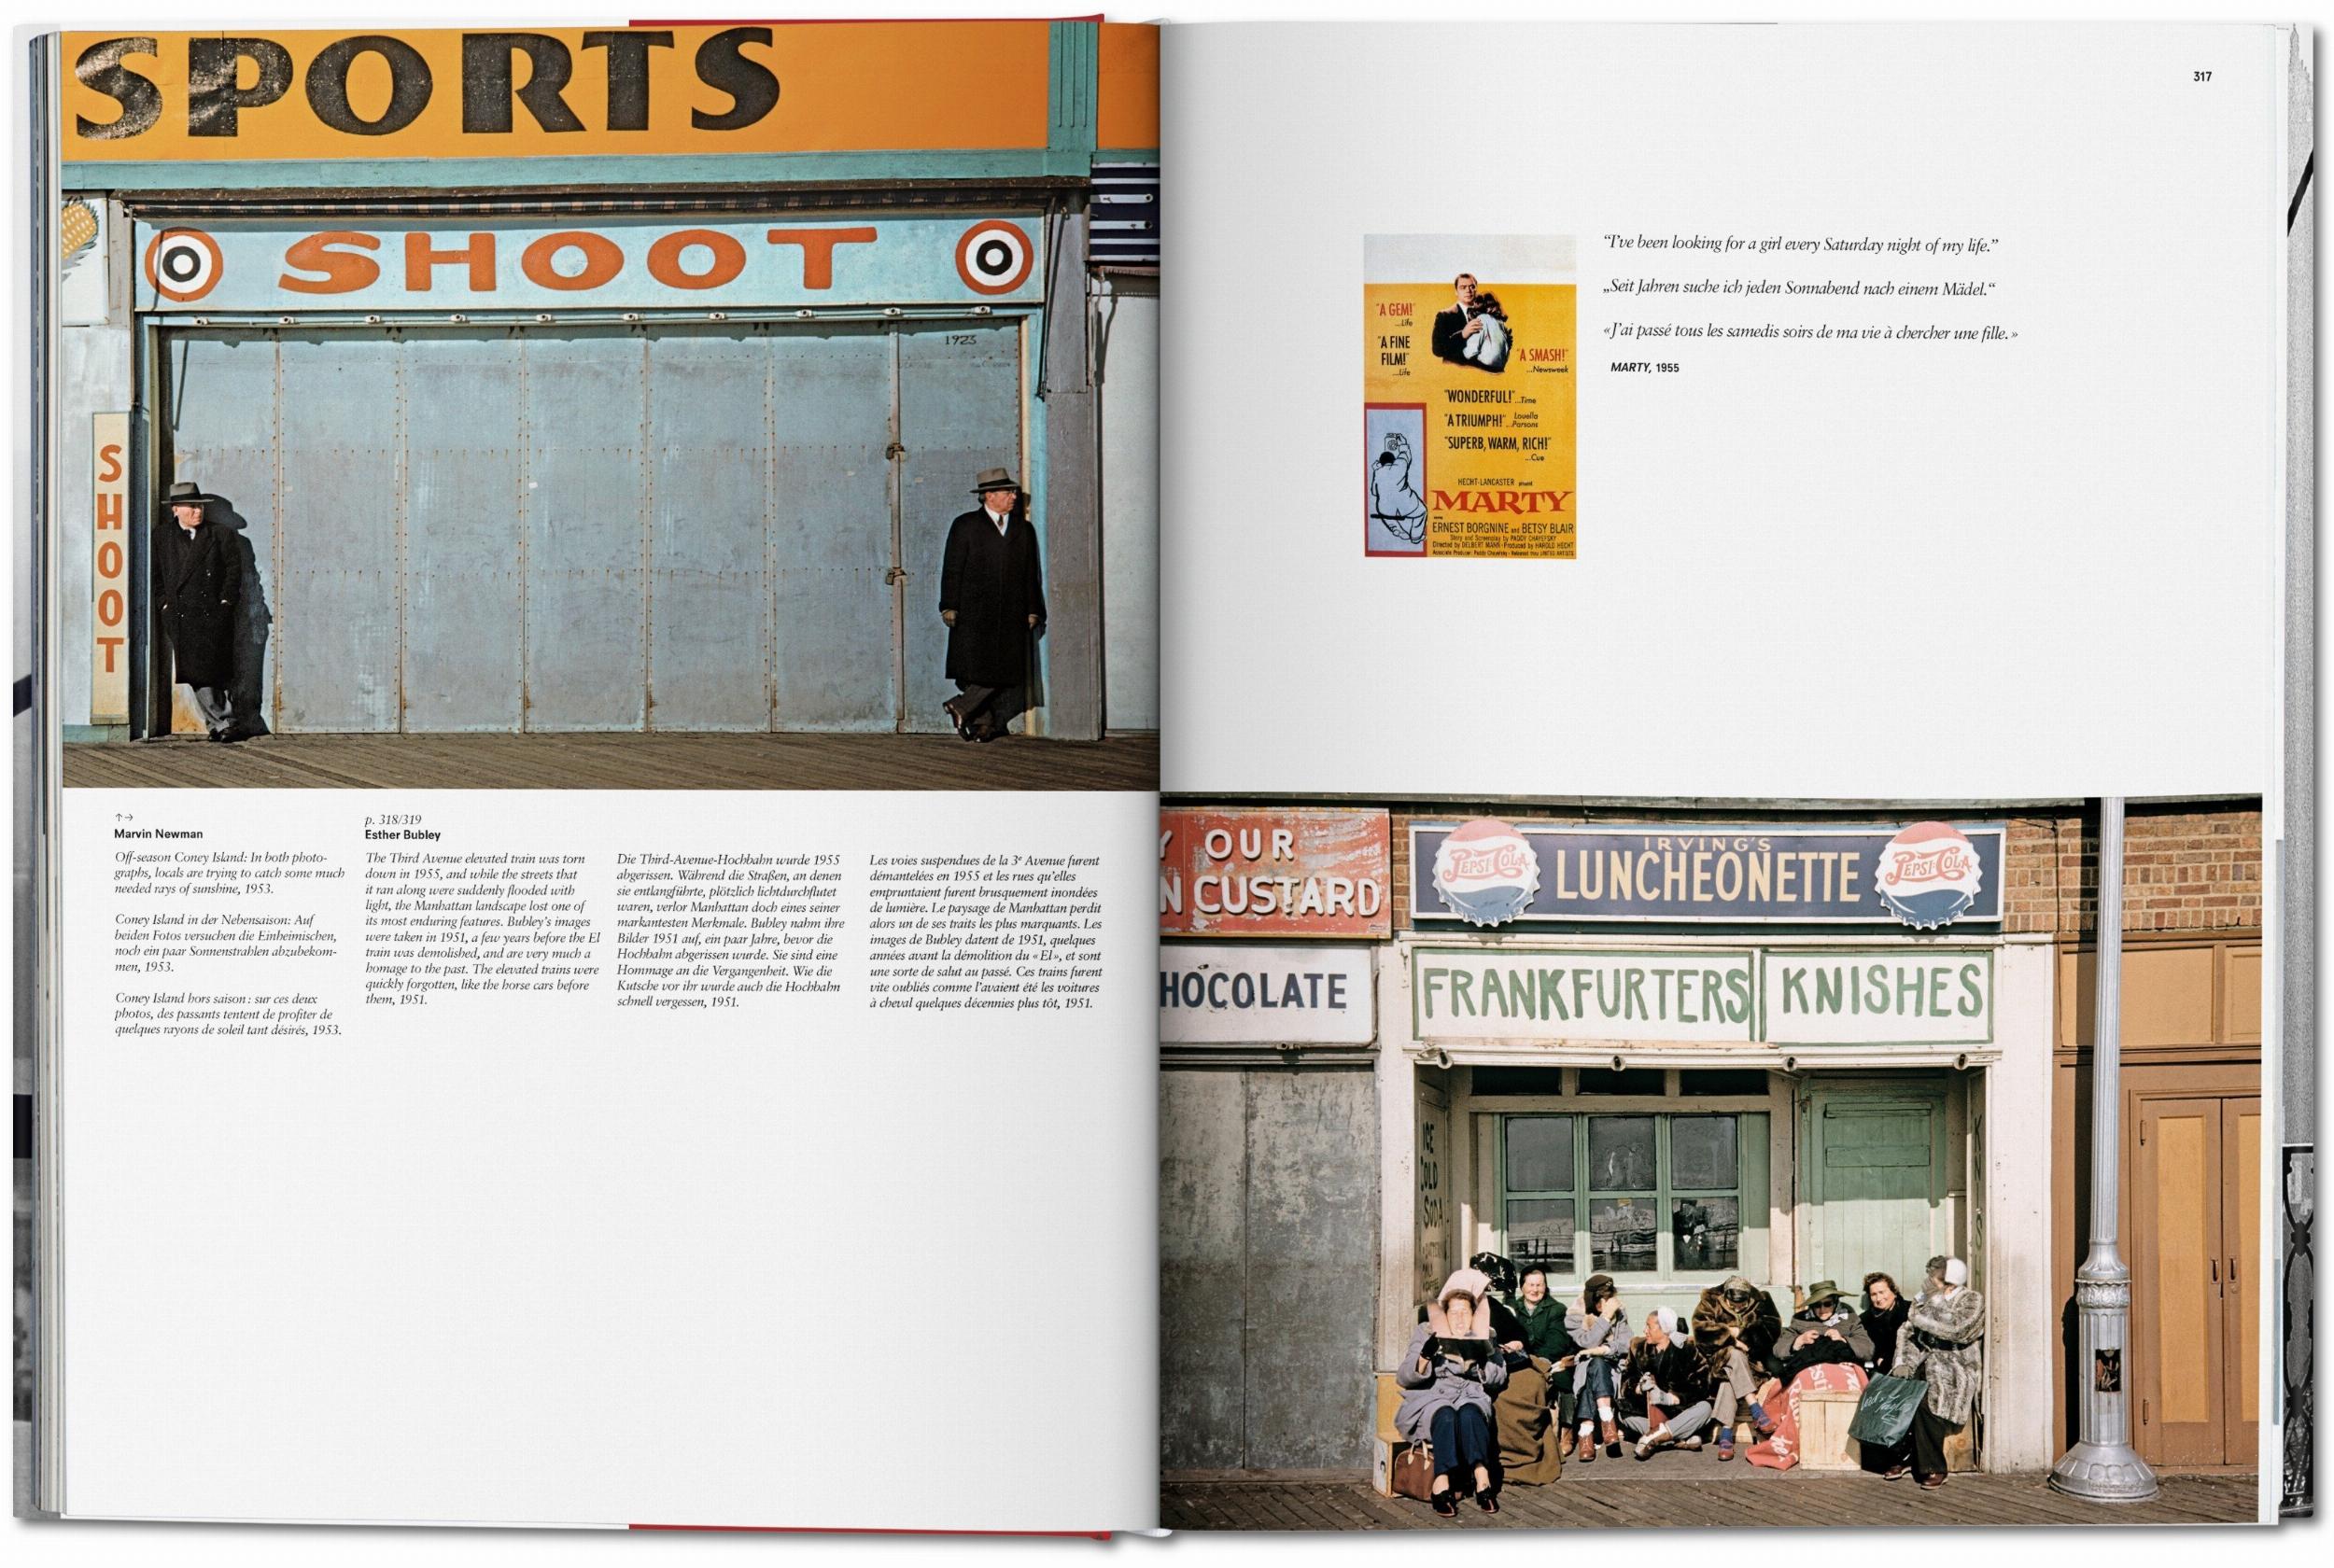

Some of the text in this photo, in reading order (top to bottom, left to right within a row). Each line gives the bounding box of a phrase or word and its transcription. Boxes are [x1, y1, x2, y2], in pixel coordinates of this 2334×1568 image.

[76, 26, 780, 140] SPORTS
[2193, 70, 2213, 82] 317
[1603, 233, 2000, 257] “I’ve been looking for a girl every Saturday night of my life.”
[278, 228, 879, 295] SHOOT
[1602, 278, 1996, 298] „Seit Jahren suche ich jeden Sonnabend nach einem Mädel.“
[1603, 321, 2018, 343] «J’ai passé tous les samedis soirs de ma vie à chercher une fille.»
[1390, 336, 1411, 349] FINE
[1381, 353, 1409, 366] FILM!"
[1529, 349, 1568, 362] SMASH!"
[1610, 361, 1680, 374] MARTY, 1955
[1444, 389, 1515, 403] "WONDERFUL!"
[1455, 414, 1506, 427] TRIUMPH!"
[1514, 412, 1539, 420] Louella
[1444, 437, 1486, 451] "SUPERB,
[1488, 437, 1520, 452] WARM,
[1430, 490, 1574, 515] MARTY
[1432, 522, 1465, 533] ERNEST
[1466, 522, 1509, 534] BORGNINE
[1522, 523, 1548, 534] BETSY
[1550, 524, 1574, 535] BLAIR
[96, 443, 125, 673] SHOOT
[364, 814, 422, 828] p. 318/319
[114, 828, 204, 839] Marvin Newman
[364, 829, 442, 843] Esther Bubley
[1204, 828, 1295, 861] OUR
[1643, 836, 1772, 852] IRVING'S
[115, 850, 328, 866] Off-season Coney Island: In both photo-
[366, 851, 585, 864] The Third Avenue elevated train was torn
[616, 852, 841, 866] Die Third-Avenue-Hochbahn wurde 1955
[869, 854, 889, 866] Les
[891, 854, 919, 866] voies
[920, 853, 980, 869] suspendues
[982, 853, 997, 866] de
[998, 854, 1009, 866] la
[1024, 855, 1066, 866] Avenue
[1066, 854, 1101, 869] furent
[113, 866, 345, 882] graphs, locals are trying to catch some much
[1556, 849, 1861, 903] LUNCHEONETTE
[114, 881, 274, 897] needed rays of sunshine, 1953.
[1193, 875, 1381, 917] CUSTARD
[1423, 967, 1750, 1024] FRANKFURTERS
[1782, 962, 1984, 1018] KNISHES
